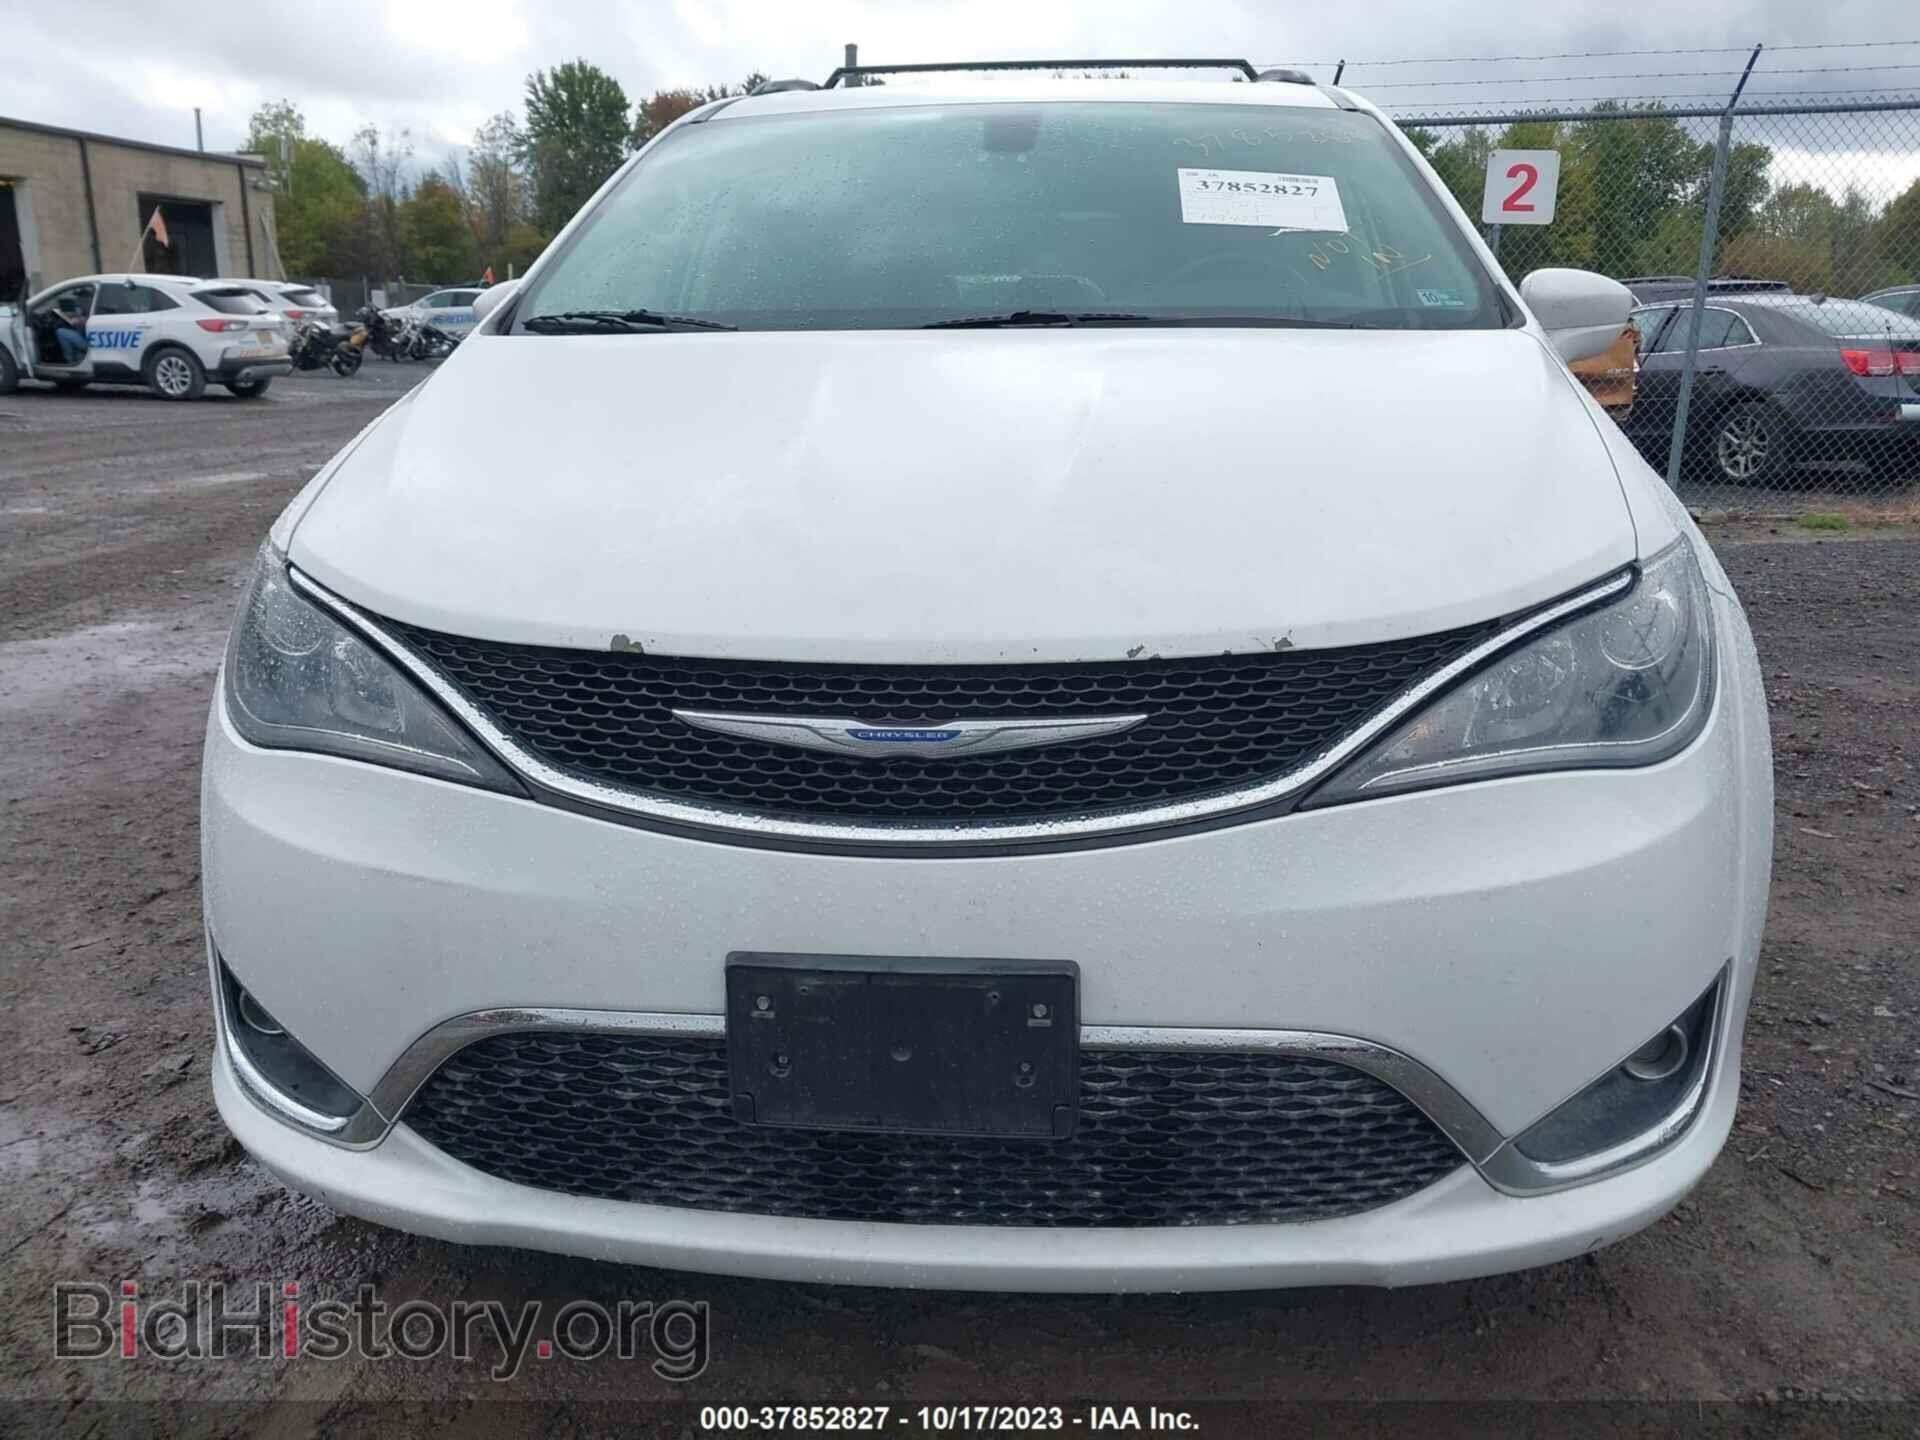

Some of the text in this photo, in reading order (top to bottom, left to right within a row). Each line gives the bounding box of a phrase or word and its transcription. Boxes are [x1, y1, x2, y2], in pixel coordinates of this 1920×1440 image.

[1196, 180, 1318, 197] 37852827
[1503, 164, 1537, 211] 2
[1422, 292, 1439, 303] 10
